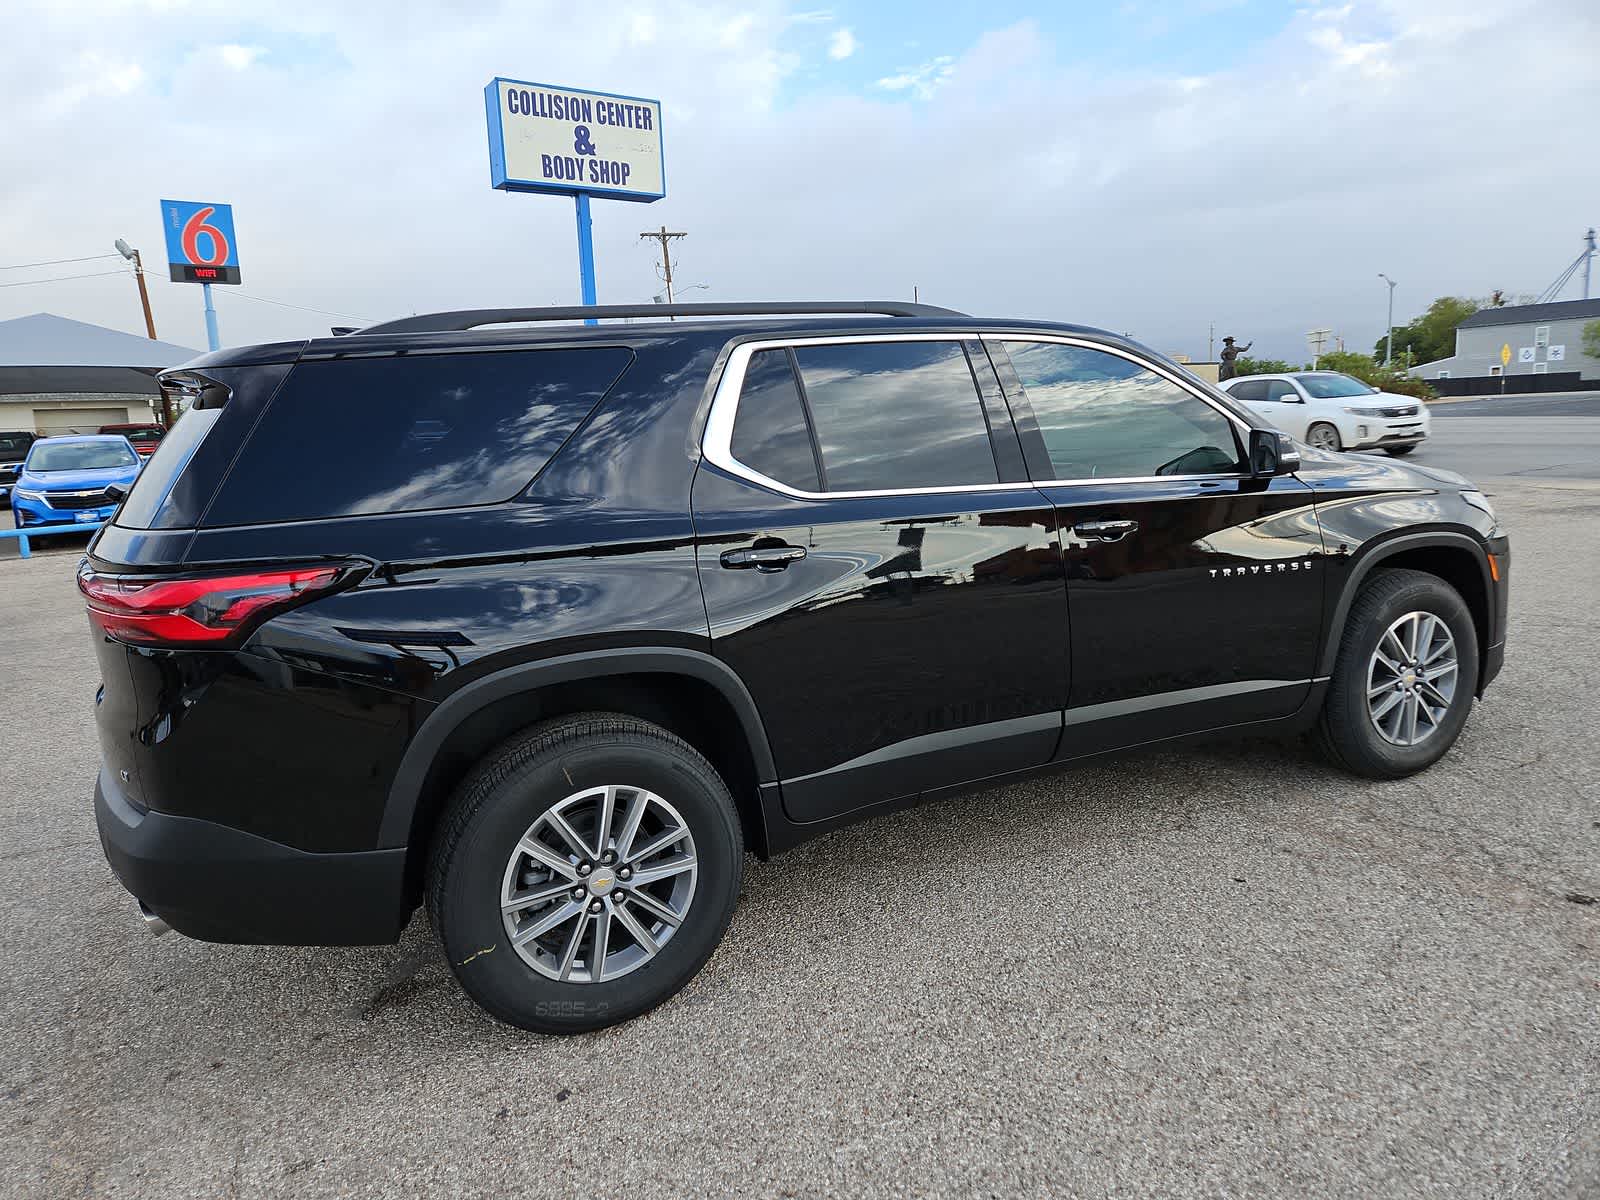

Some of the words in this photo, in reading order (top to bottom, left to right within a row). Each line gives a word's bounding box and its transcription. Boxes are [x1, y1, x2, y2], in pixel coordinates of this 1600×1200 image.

[507, 88, 593, 124] COLLISION
[595, 100, 653, 131] CENTER
[573, 124, 597, 156] &
[541, 153, 586, 182] BODY
[588, 158, 631, 186] SHOP
[180, 205, 230, 266] 6
[1208, 560, 1313, 578] TRAVERSE
